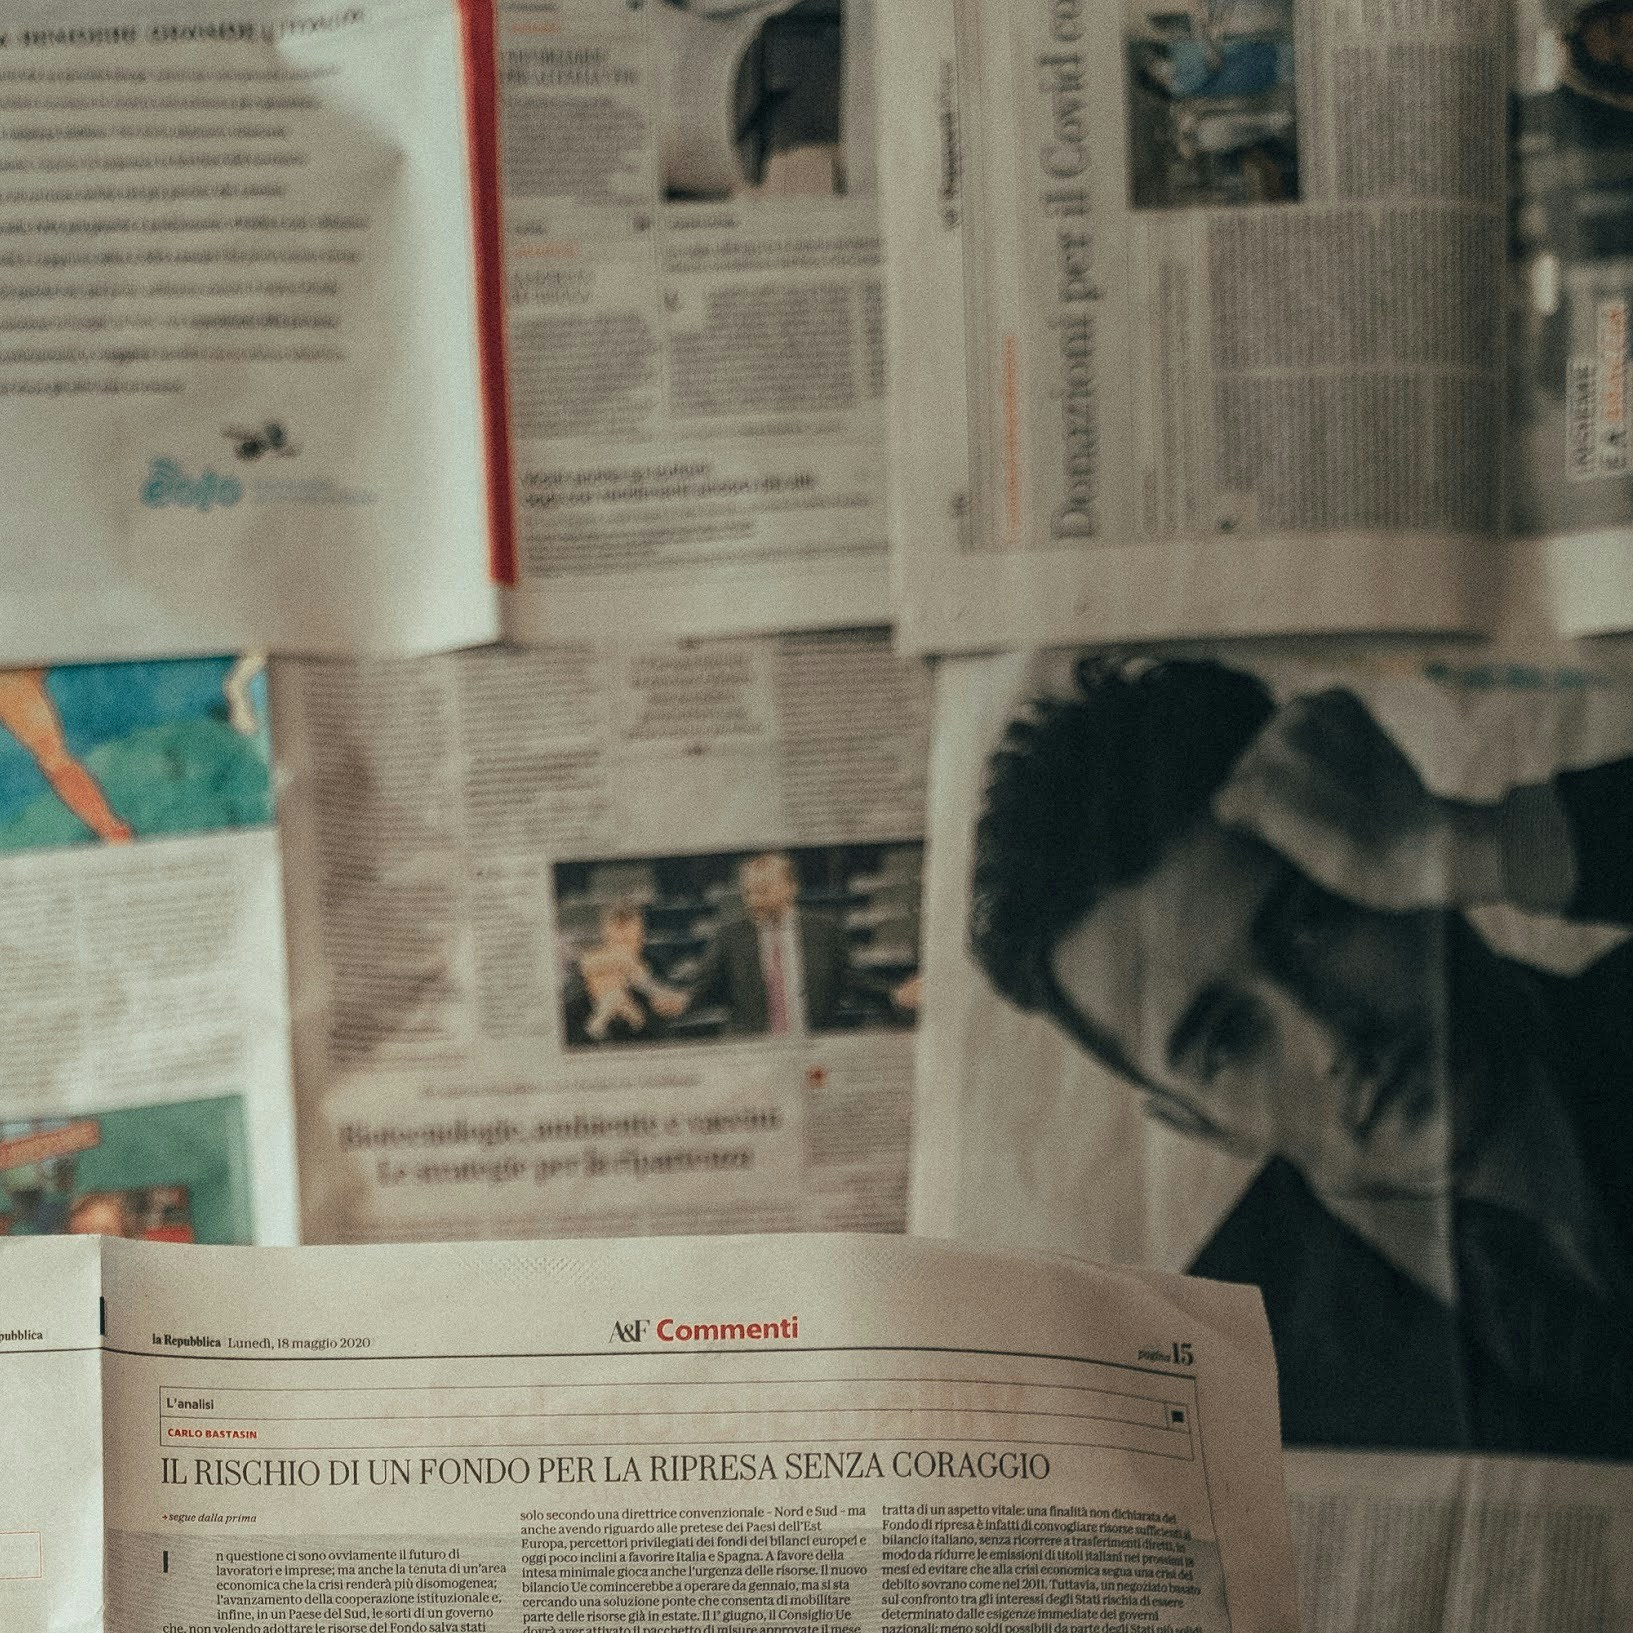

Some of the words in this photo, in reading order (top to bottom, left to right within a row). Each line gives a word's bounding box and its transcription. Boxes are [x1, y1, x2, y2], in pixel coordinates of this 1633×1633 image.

[1035, 54, 1092, 180] Covid
[608, 1318, 651, 1343] A&F
[656, 1315, 799, 1342] Commenti
[163, 1333, 222, 1349] Repubblica
[227, 1336, 275, 1351] Lunedì,
[276, 1337, 291, 1350] 18
[291, 1338, 338, 1352] maggio
[338, 1337, 372, 1350] 2020
[1171, 1342, 1195, 1367] 15
[166, 1397, 215, 1410] L'analisi
[167, 1427, 203, 1438] CARLO
[205, 1429, 257, 1439] BASTASIN
[160, 1457, 190, 1487] IL
[193, 1457, 321, 1486] RISCHIO
[328, 1456, 360, 1486] DI
[368, 1455, 412, 1485] UN
[418, 1455, 531, 1485] FONDO
[537, 1454, 596, 1484] PER
[603, 1454, 642, 1484] LA
[648, 1453, 778, 1483] RIPRESA
[784, 1452, 885, 1482] SENZA
[892, 1451, 1051, 1481] CORAGGIO
[169, 1512, 197, 1525] segue
[197, 1513, 224, 1523] dalla
[224, 1515, 257, 1525] prima
